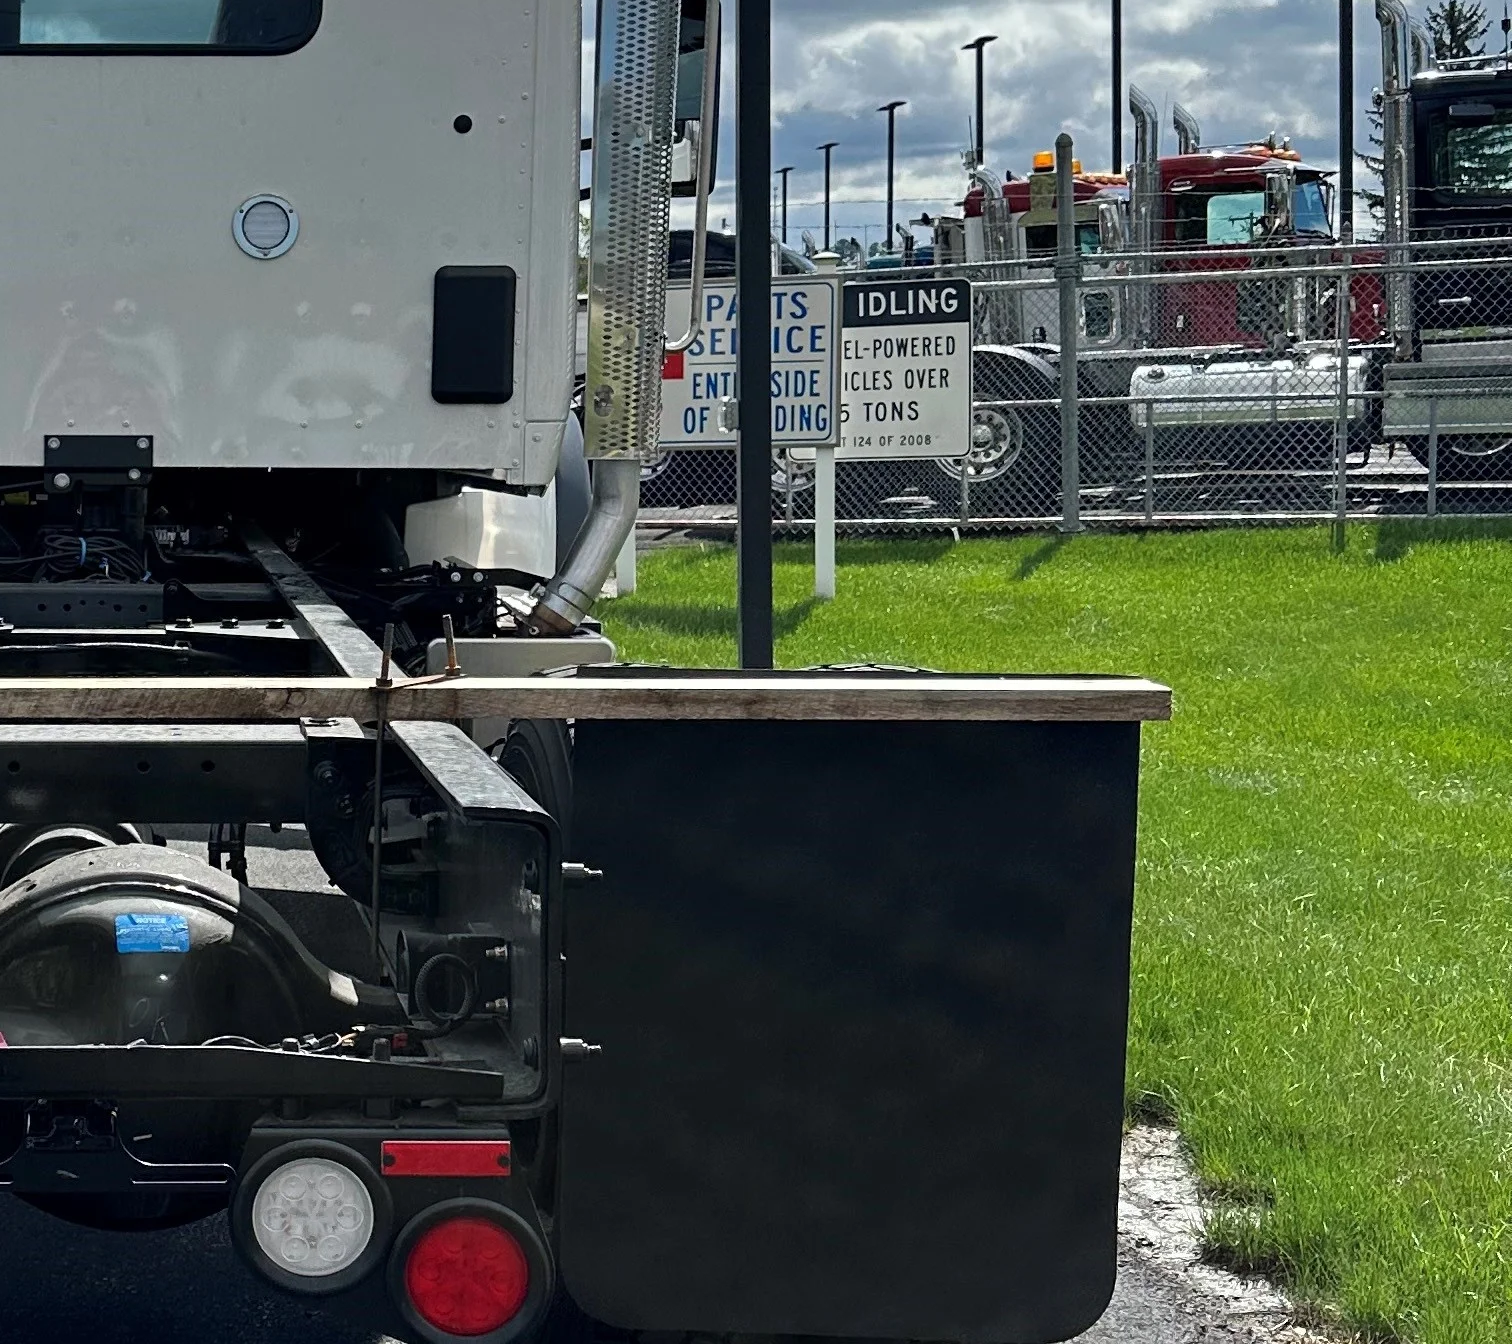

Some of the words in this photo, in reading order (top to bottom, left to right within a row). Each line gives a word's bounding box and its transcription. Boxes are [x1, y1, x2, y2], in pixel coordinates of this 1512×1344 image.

[858, 287, 959, 317] IDLING
[688, 325, 826, 357] SEICE
[843, 335, 956, 360] EL-POWERED
[771, 369, 821, 399] SIDE
[904, 368, 950, 390] OVER
[683, 406, 711, 434] OF
[862, 400, 919, 423] TONS
[853, 436, 872, 448] 124
[879, 435, 894, 447] OF
[899, 434, 932, 447] 2008
